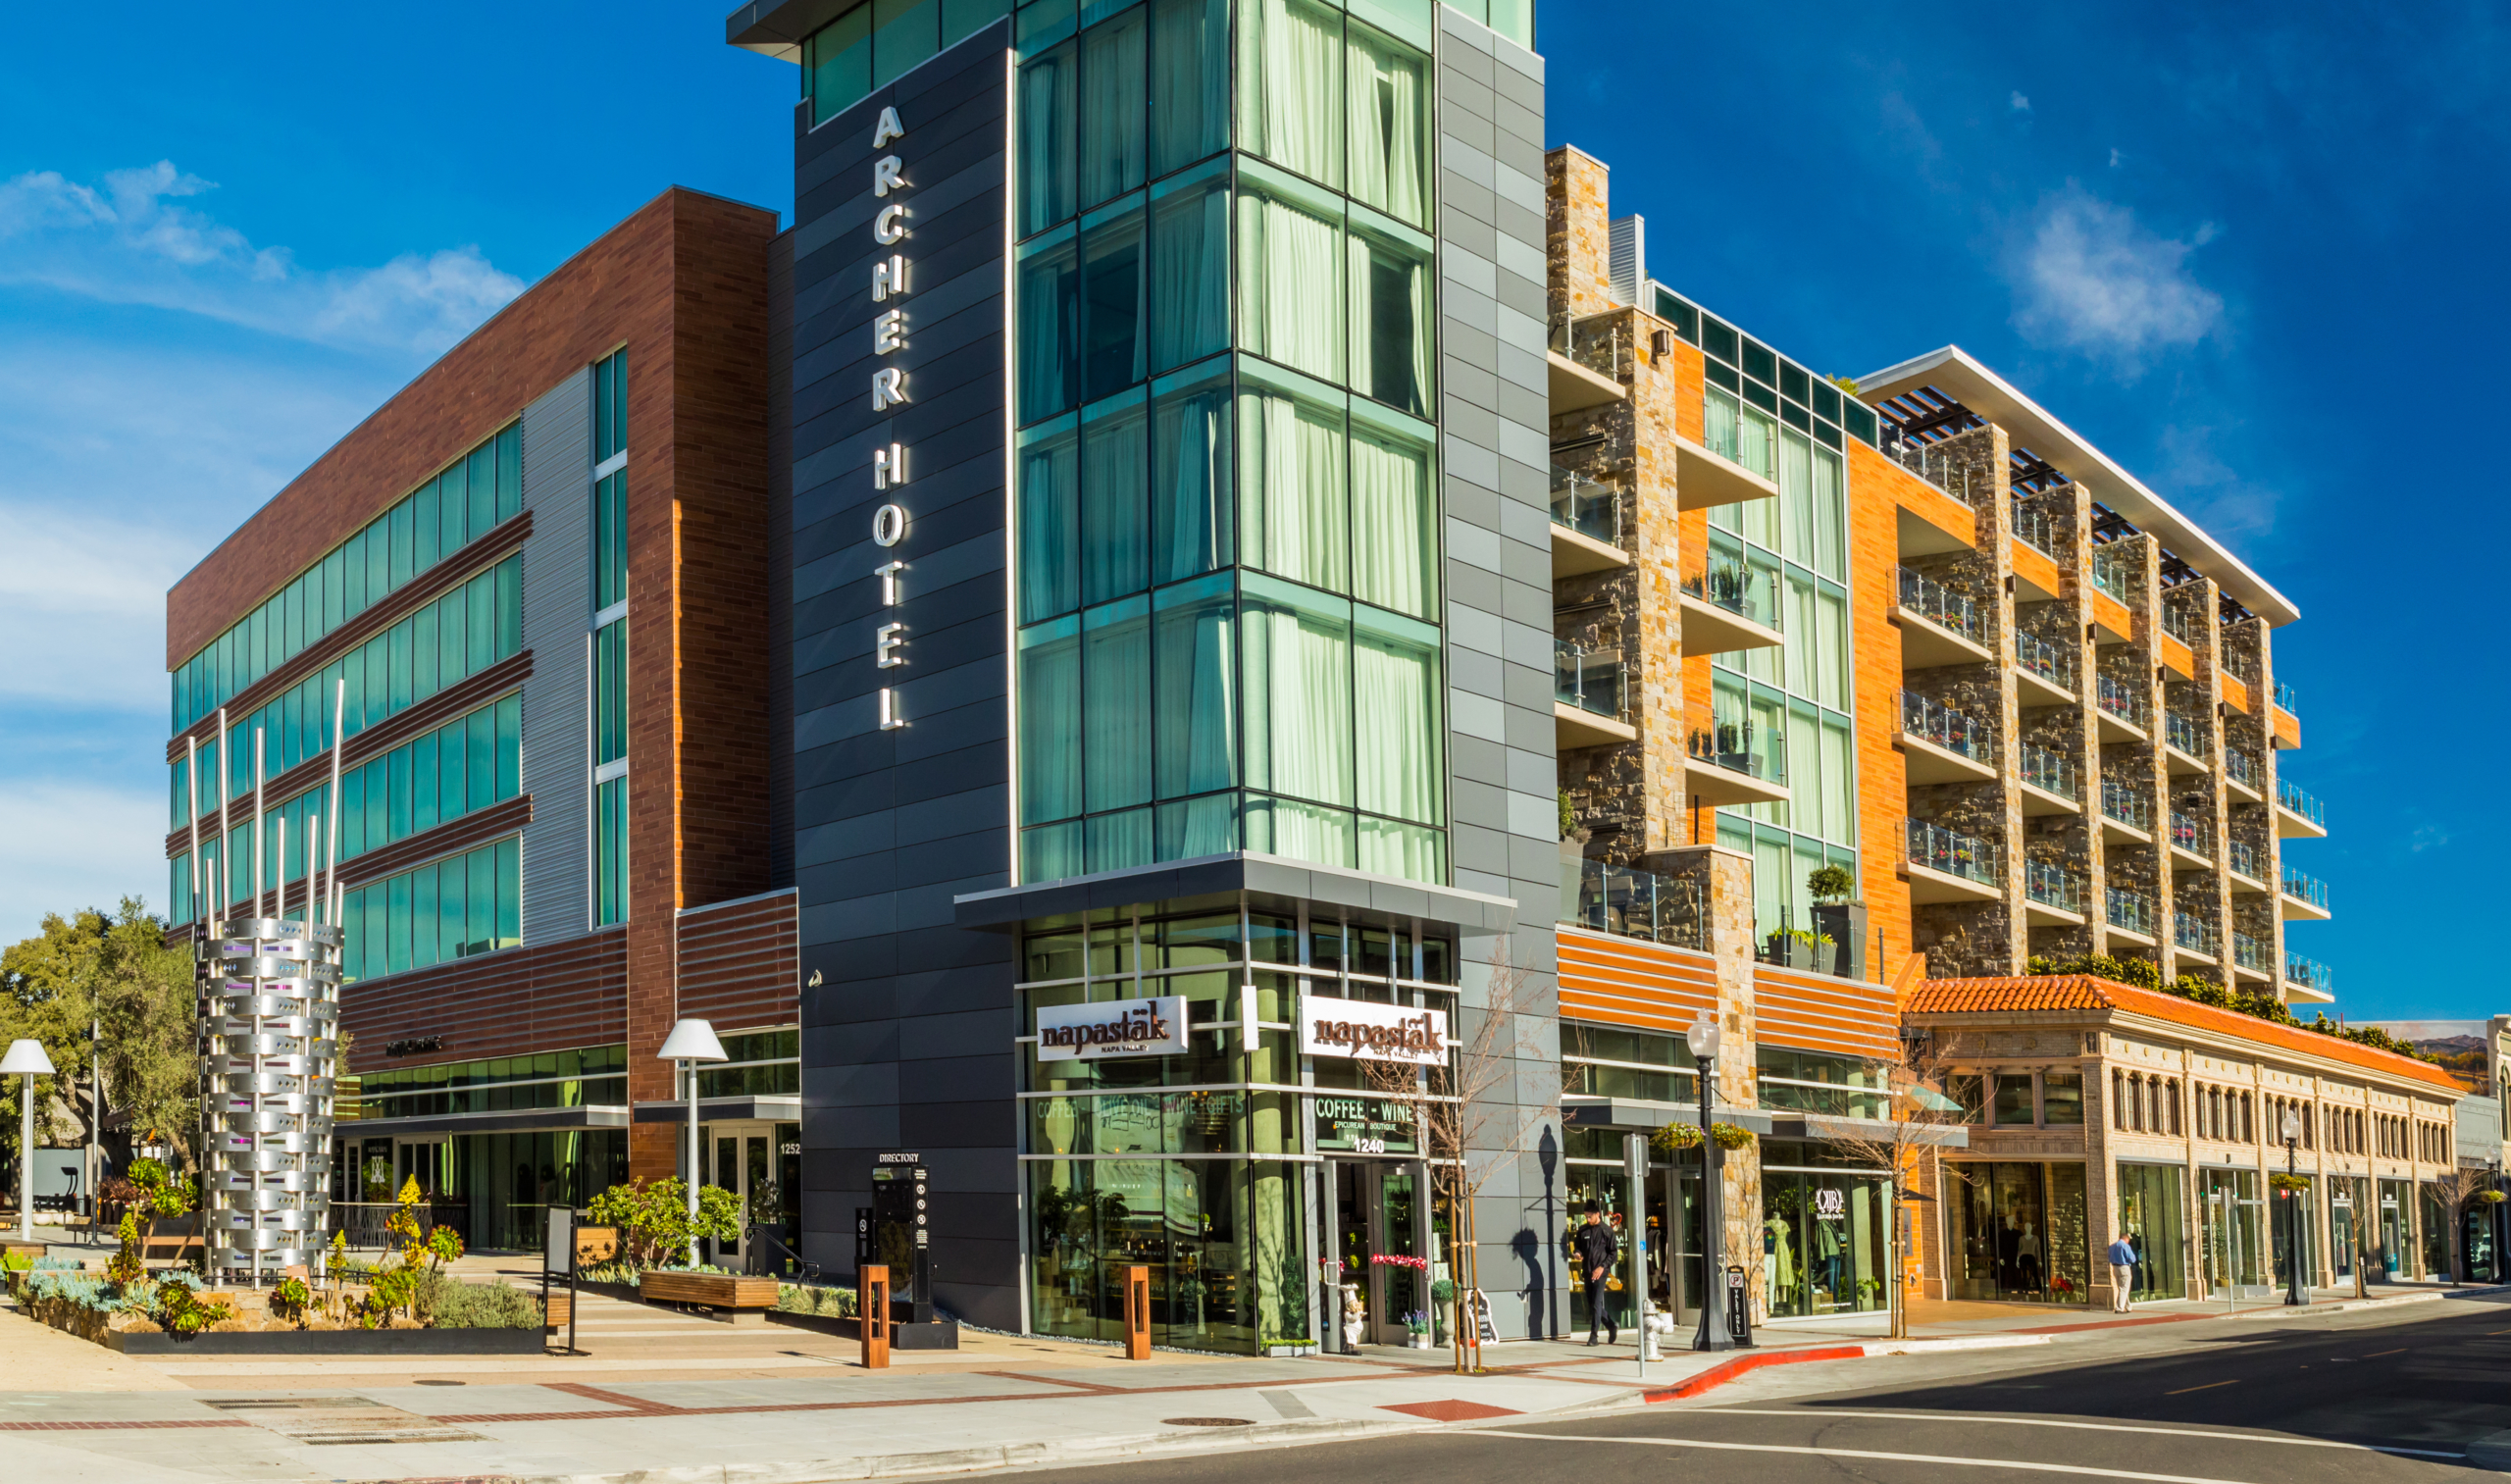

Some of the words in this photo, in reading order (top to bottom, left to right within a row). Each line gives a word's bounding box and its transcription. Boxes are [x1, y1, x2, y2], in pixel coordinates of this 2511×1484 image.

[873, 106, 904, 412] ARCHER
[873, 442, 903, 731] HOTEL
[1041, 1000, 1170, 1055] napastäk
[1314, 1012, 1444, 1054] napastäk
[1122, 1044, 1150, 1052] VALLEY
[1373, 1049, 1392, 1057] NAPA
[1394, 1050, 1419, 1060] VALLEY
[1037, 1100, 1077, 1119] COFFEE
[1132, 1098, 1152, 1116] OIL
[1206, 1095, 1245, 1114] GIFTS
[1315, 1098, 1365, 1119] COFFEE
[1380, 1100, 1413, 1122] WINE
[1335, 1120, 1365, 1130] EPICUREAN
[1369, 1122, 1397, 1131] BOUTIQUE
[780, 1143, 801, 1154] 1252
[1354, 1138, 1385, 1153] 1240
[879, 1152, 919, 1163] DIRECTORY
